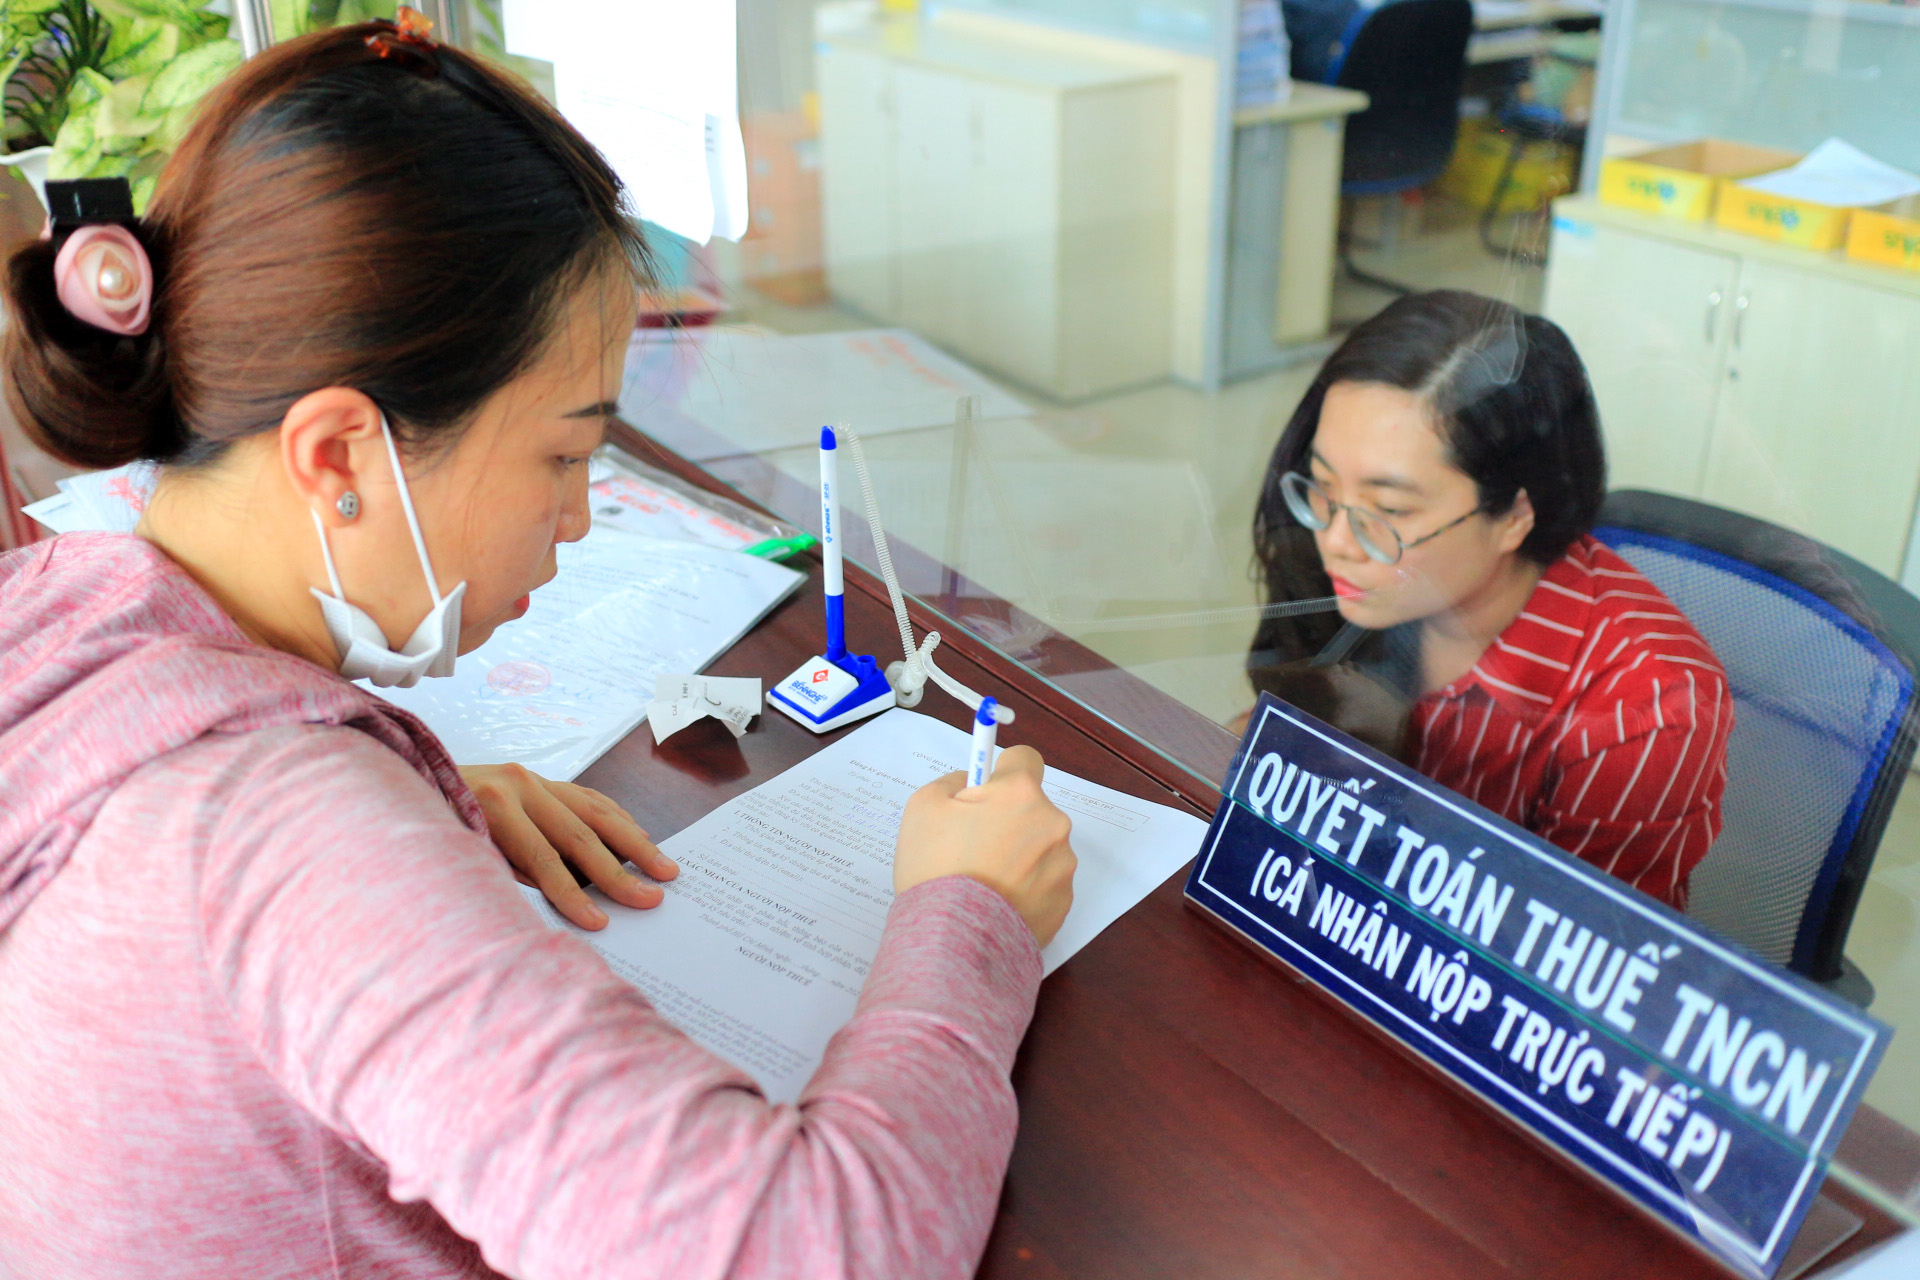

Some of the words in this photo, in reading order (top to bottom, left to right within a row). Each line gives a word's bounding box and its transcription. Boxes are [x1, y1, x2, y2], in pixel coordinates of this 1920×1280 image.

[1248, 751, 1387, 883] QUYẾT
[1382, 823, 1515, 948] TOÁN
[1506, 899, 1683, 1033] THUẾ
[1661, 983, 1831, 1136] TNCN
[1249, 847, 1314, 918] (CÁ
[1311, 890, 1410, 980] NHÂN
[1405, 950, 1492, 1027] NỘP
[1491, 997, 1606, 1106] TRỰC
[1605, 1067, 1734, 1194] TIẾP)
